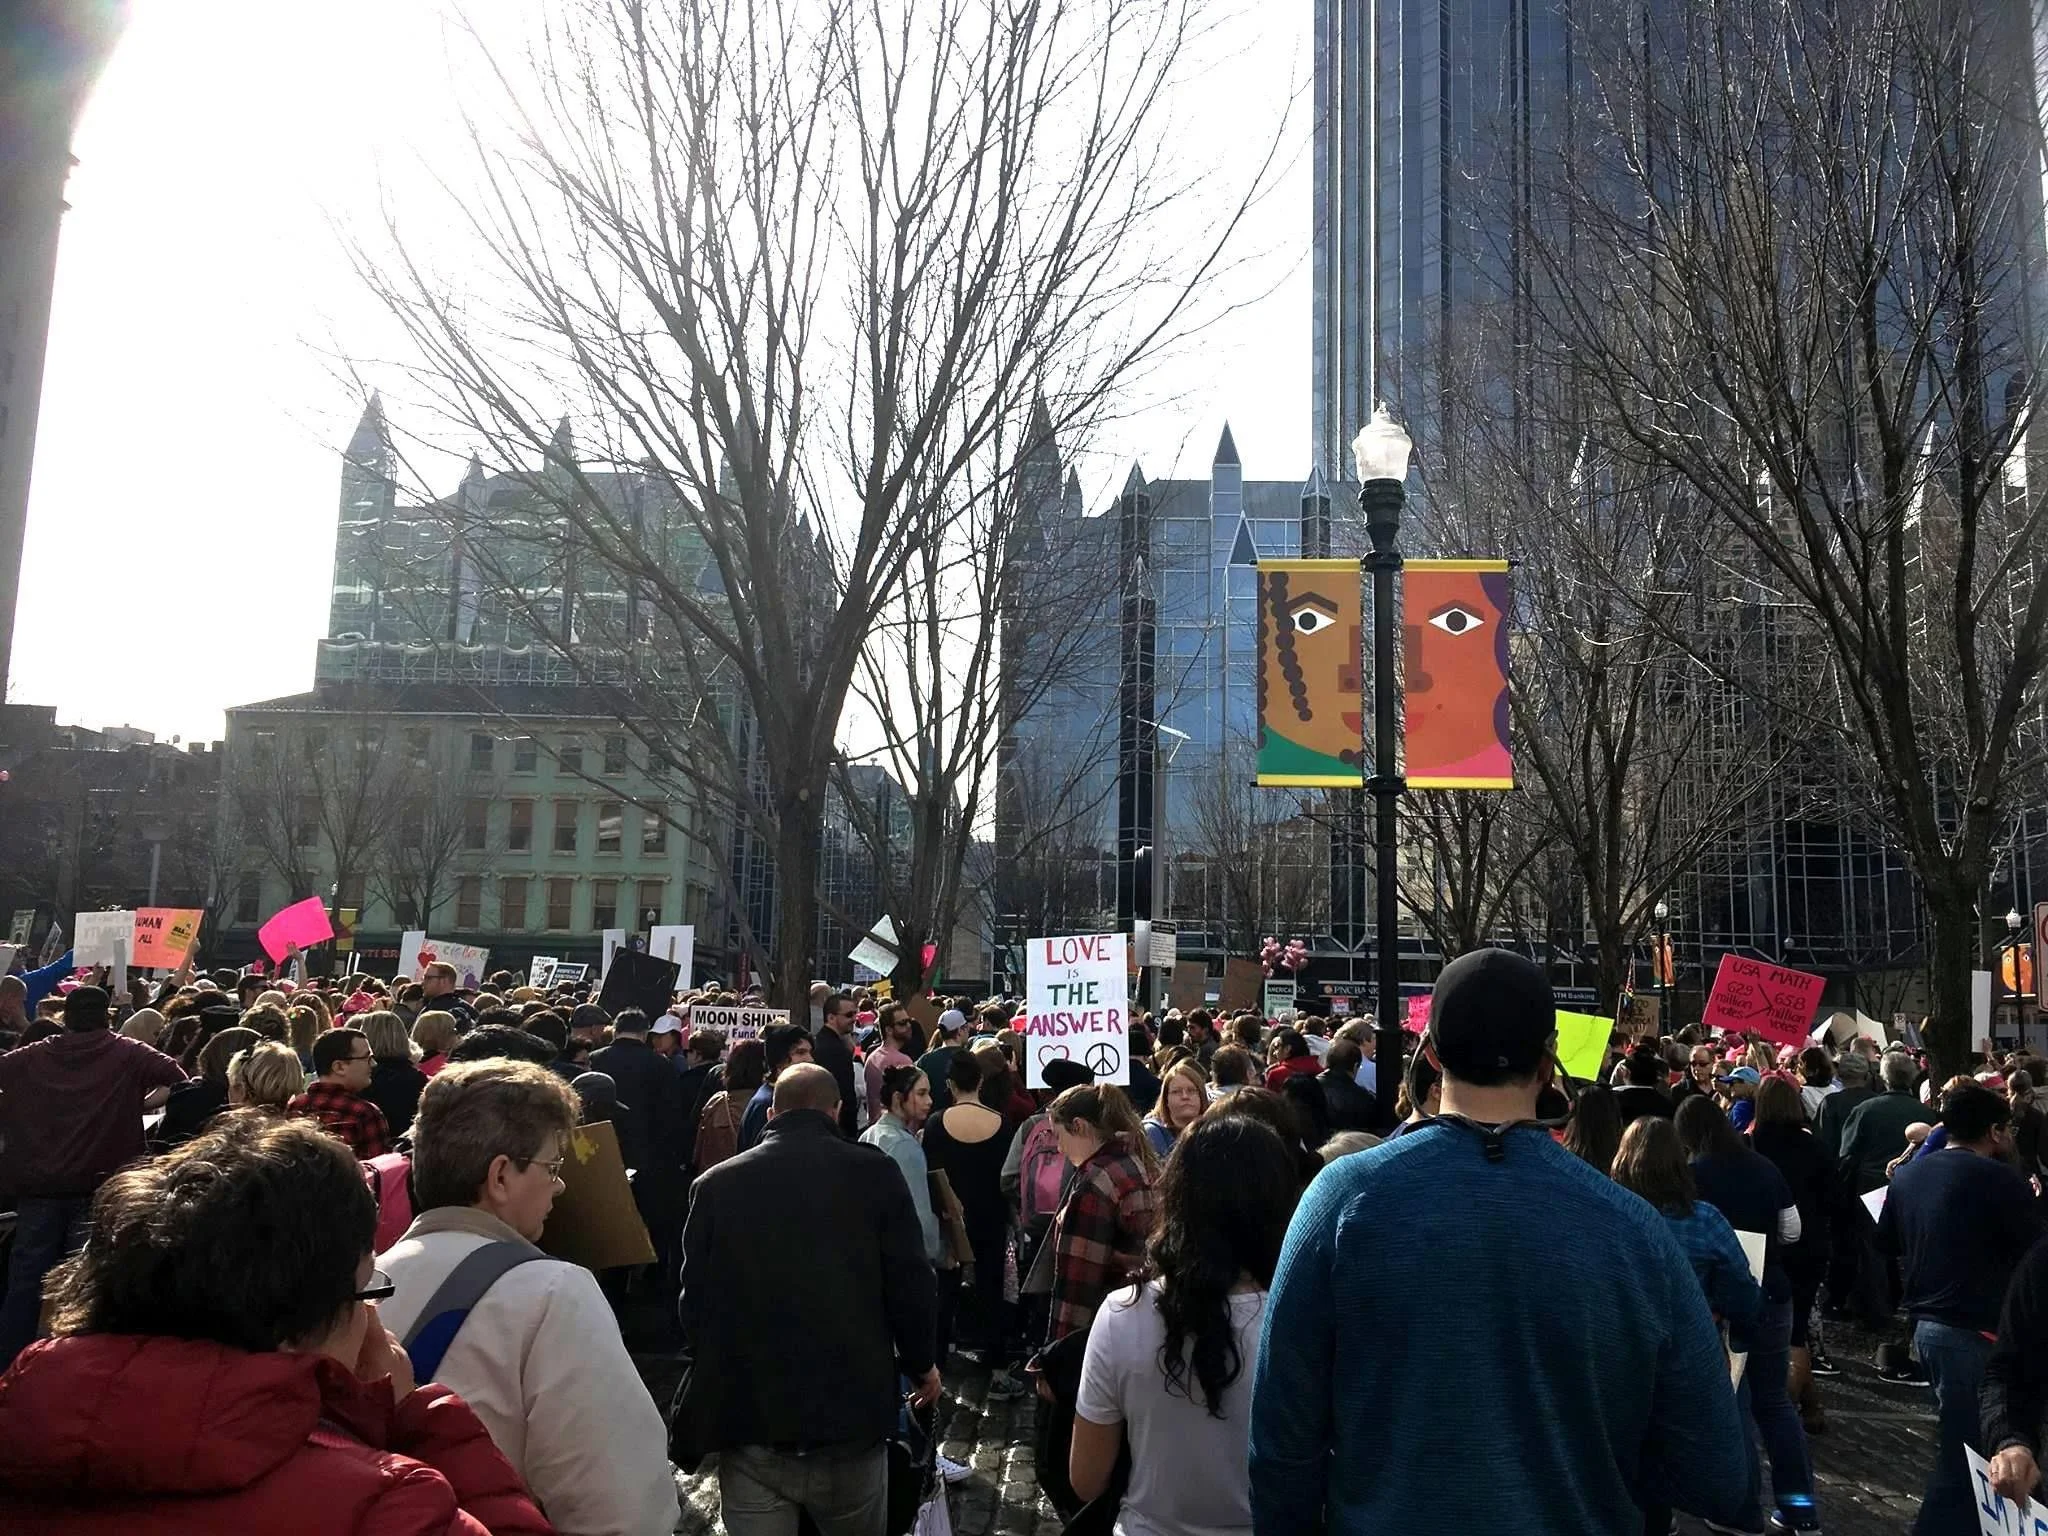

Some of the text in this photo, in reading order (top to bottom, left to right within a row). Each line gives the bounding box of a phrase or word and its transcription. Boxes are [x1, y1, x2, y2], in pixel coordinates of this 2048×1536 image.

[1046, 935, 1112, 965] LOVE
[1732, 962, 1812, 990] USA MATH
[1047, 981, 1099, 1006] THE
[1334, 986, 1351, 994] PNC
[1567, 992, 1596, 1001] Banking
[1714, 992, 1753, 1010] million
[695, 1010, 786, 1027] MOON SHIN
[1716, 1005, 1744, 1020] votes
[1766, 1006, 1807, 1025] million
[1027, 1008, 1123, 1037] ANSWER
[1769, 1019, 1798, 1034] votes
